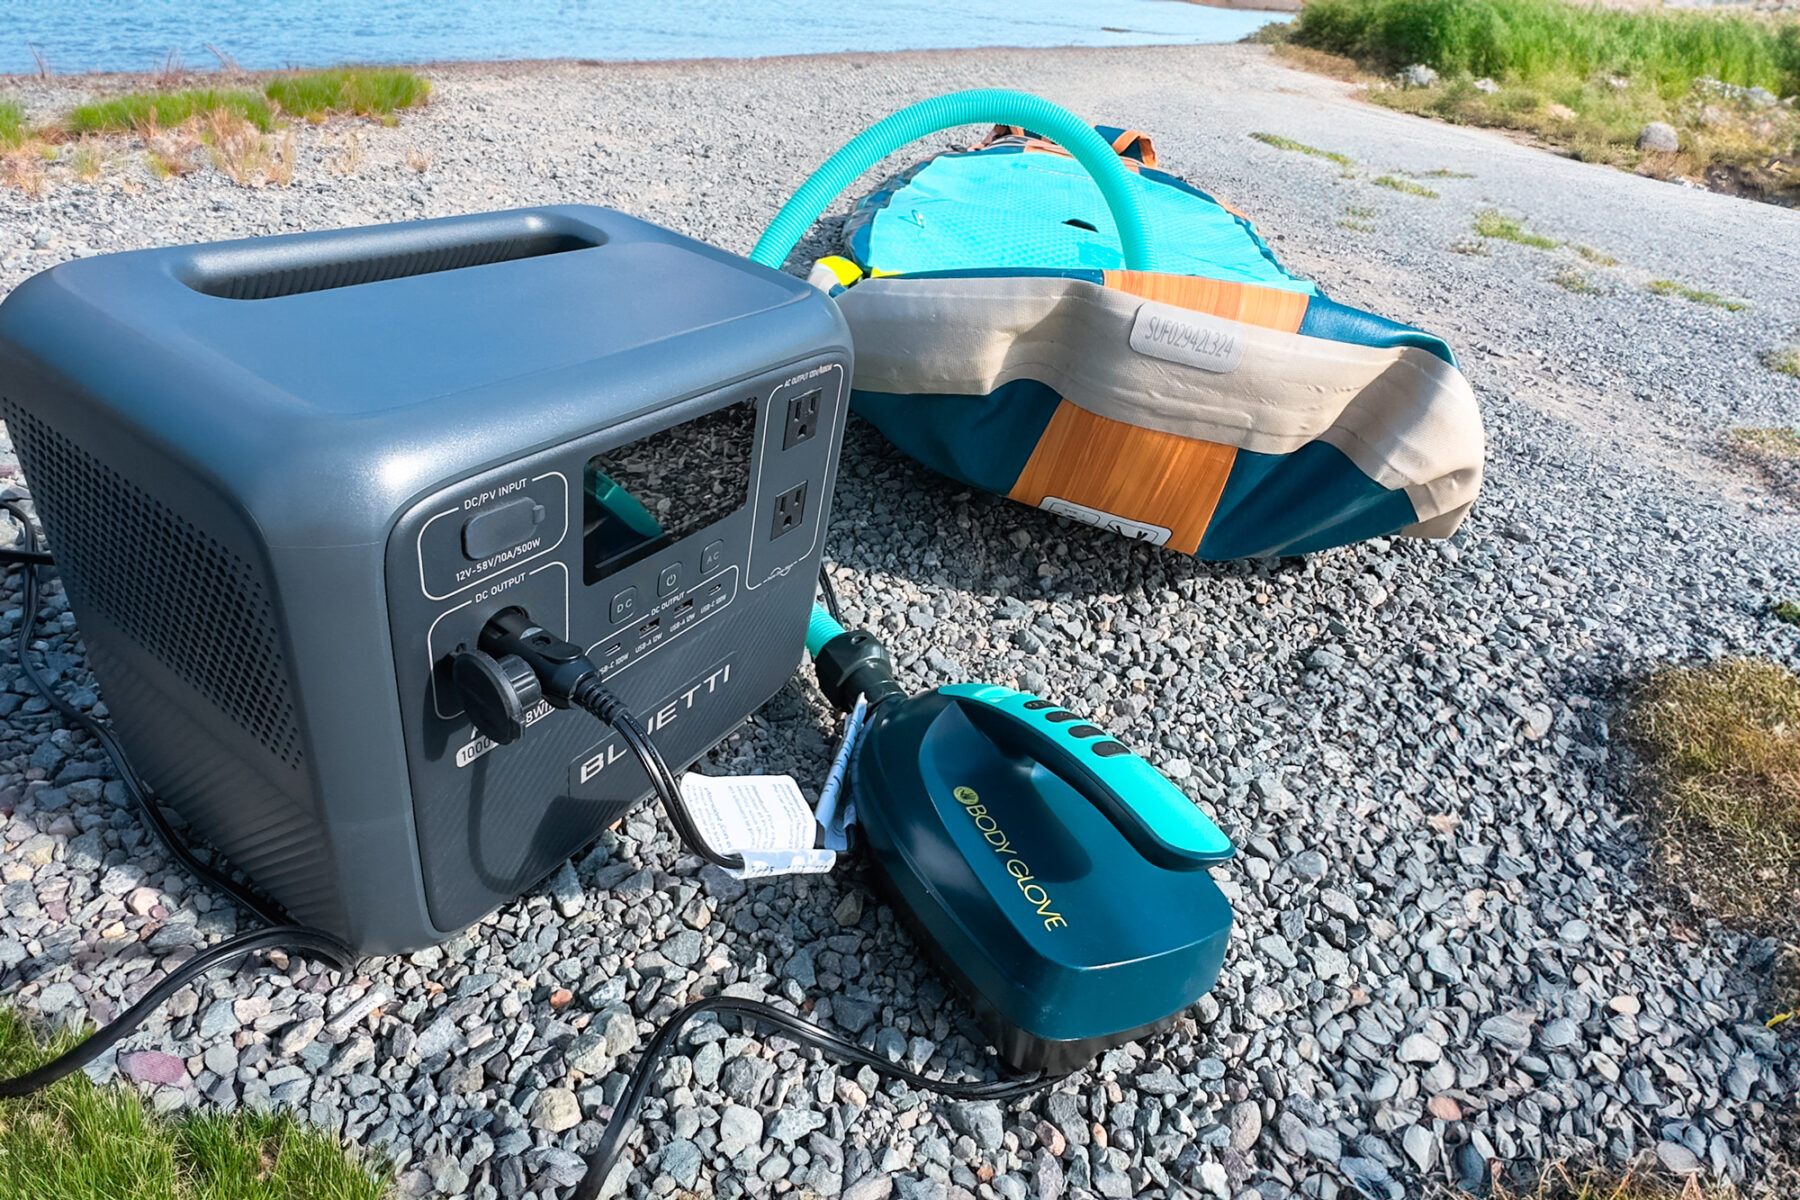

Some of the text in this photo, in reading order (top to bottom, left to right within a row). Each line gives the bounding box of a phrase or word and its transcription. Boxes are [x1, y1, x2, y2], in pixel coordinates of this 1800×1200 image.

[464, 478, 528, 510] DC/PV INPUT
[455, 537, 541, 582] 12V-58V/10A/500W
[706, 551, 720, 565] AC
[475, 572, 526, 602] DC OUTPUT
[616, 598, 633, 614] DC
[660, 591, 686, 611] OUTPUT
[635, 638, 653, 653] USB-A
[598, 659, 615, 675] SB-C
[966, 804, 1068, 932] BODY GLOVE
